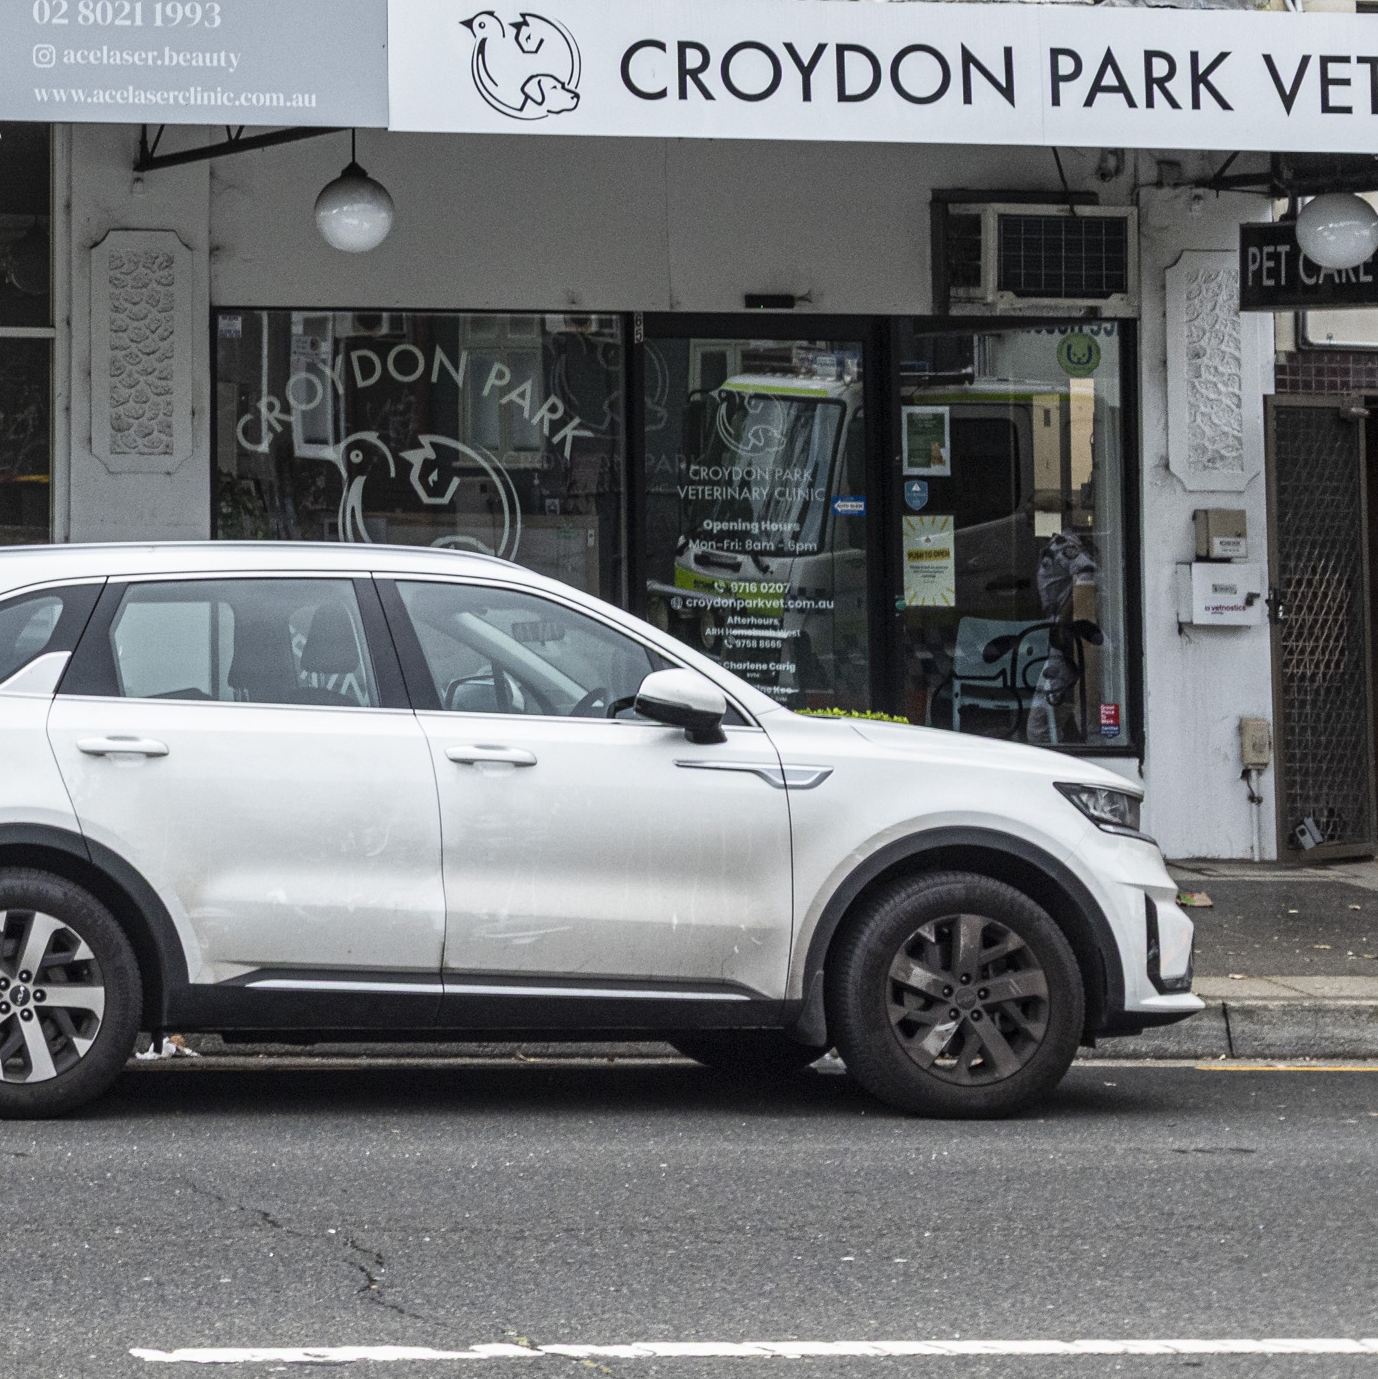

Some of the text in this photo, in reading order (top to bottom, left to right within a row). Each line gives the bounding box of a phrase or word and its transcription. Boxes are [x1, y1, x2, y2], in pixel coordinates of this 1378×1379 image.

[76, 0, 144, 27] 8021
[153, 2, 222, 29] 1993
[62, 44, 242, 74] acelaser.beauty
[620, 38, 1016, 108] CROYDON
[1049, 46, 1234, 112] PARK
[34, 84, 318, 109] www.acelaserclinic.com.au
[1248, 245, 1290, 286] PET
[235, 342, 594, 460] CROYDON PARK
[689, 466, 812, 482] CROYDON PARK
[678, 485, 826, 502] VETERINARY CLINIC
[703, 519, 800, 534] Opening Hours
[689, 539, 742, 550] Mon-Fri:
[745, 540, 774, 551] 8am
[788, 541, 817, 553] 6pm
[731, 582, 757, 593] 9716
[760, 582, 790, 593] 0207
[686, 596, 835, 610] croydonparkvet.com.au
